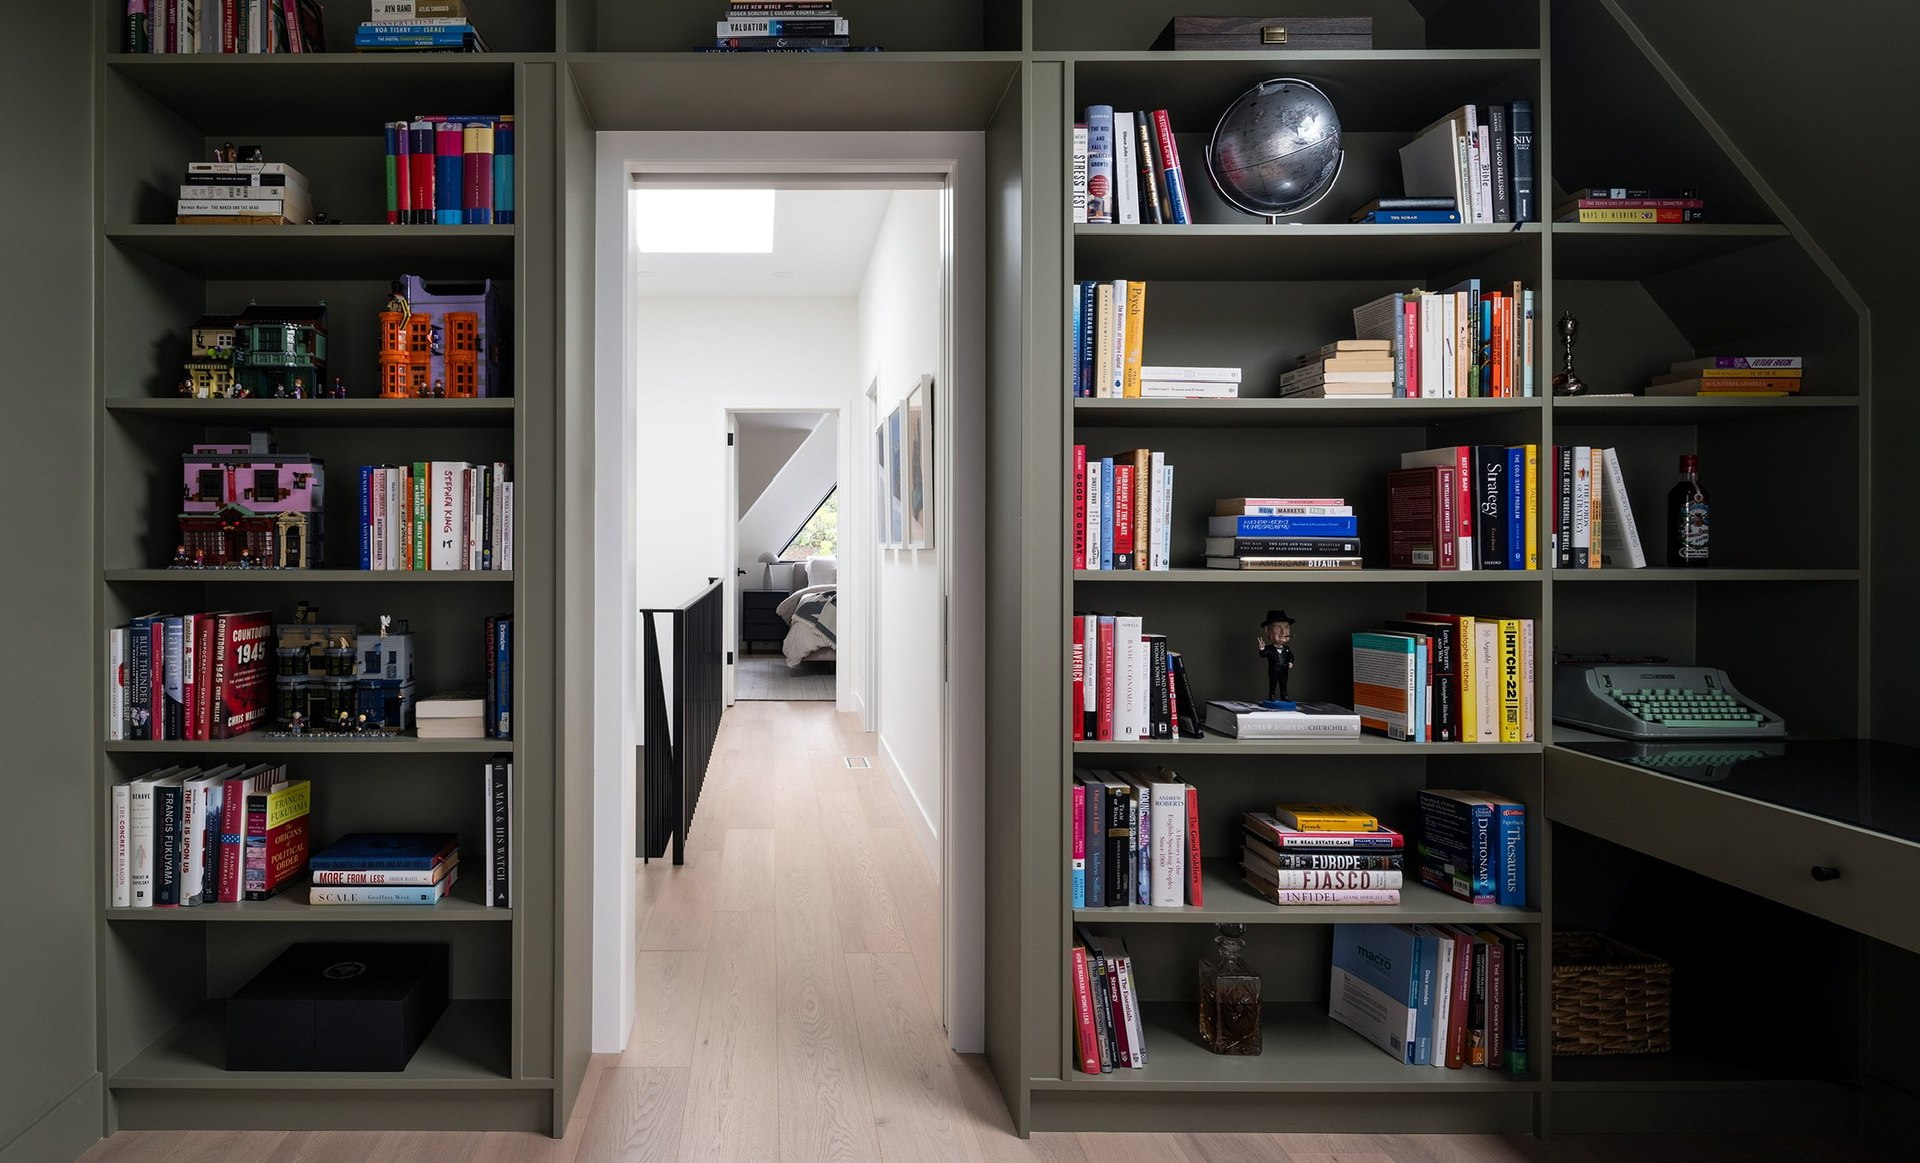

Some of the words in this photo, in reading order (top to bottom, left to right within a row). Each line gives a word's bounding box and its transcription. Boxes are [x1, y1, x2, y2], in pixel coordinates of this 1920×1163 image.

[385, 4, 396, 13] AYN
[396, 4, 412, 13] RAND
[730, 22, 768, 32] VALUATION
[1513, 136, 1532, 144] NIV
[1074, 154, 1086, 186] STRESS
[1074, 190, 1086, 210] TEST
[1129, 287, 1143, 315] Psych
[444, 470, 453, 507] STEPHEN
[1482, 463, 1503, 518] Strategy
[444, 510, 453, 534] KING
[1076, 507, 1083, 518] TO
[1308, 560, 1340, 568] DEFAULT
[217, 619, 226, 660] COUNTDOWN
[232, 624, 271, 642] COUNTDOWN
[140, 635, 148, 656] BLUE
[166, 624, 183, 680] Harper
[236, 642, 266, 665] 1945
[487, 622, 495, 675] AUDACITY
[216, 663, 224, 683] 1945
[1073, 643, 1084, 682] MAVERICK
[1507, 634, 1517, 699] HITCH-22
[140, 660, 148, 704] THUNDER
[164, 793, 175, 832] FRANCIS
[496, 791, 504, 813] MAN
[185, 826, 191, 835] IS
[1190, 816, 1198, 830] The
[275, 827, 302, 844] ORIGINS
[497, 827, 505, 844] HIS
[1191, 830, 1200, 851] Good
[164, 835, 174, 885] FUKUYAMA
[271, 843, 305, 864] POLITICAL
[276, 855, 299, 871] ORDER
[497, 846, 506, 880] WATCH
[1093, 851, 1101, 876] Andrew
[1312, 855, 1361, 869] EUROPE
[1478, 818, 1488, 887] DICTIONARY
[1507, 826, 1521, 892] Thesaurus
[183, 862, 190, 874] US
[319, 873, 344, 884] MORE
[347, 874, 367, 884] FROM
[370, 874, 385, 883] LESS
[1192, 852, 1200, 884] Soldiers
[1302, 870, 1371, 890] FIASCO
[319, 894, 358, 902] SCALE
[1286, 892, 1339, 902] INFIDEL
[1357, 944, 1391, 971] macro
[1078, 964, 1087, 994] REMARKABLE
[1110, 976, 1119, 1003] Strategy
[1093, 979, 1103, 1005] Titanium
[1123, 991, 1133, 1022] Essentials
[1097, 1006, 1105, 1036] Economy
